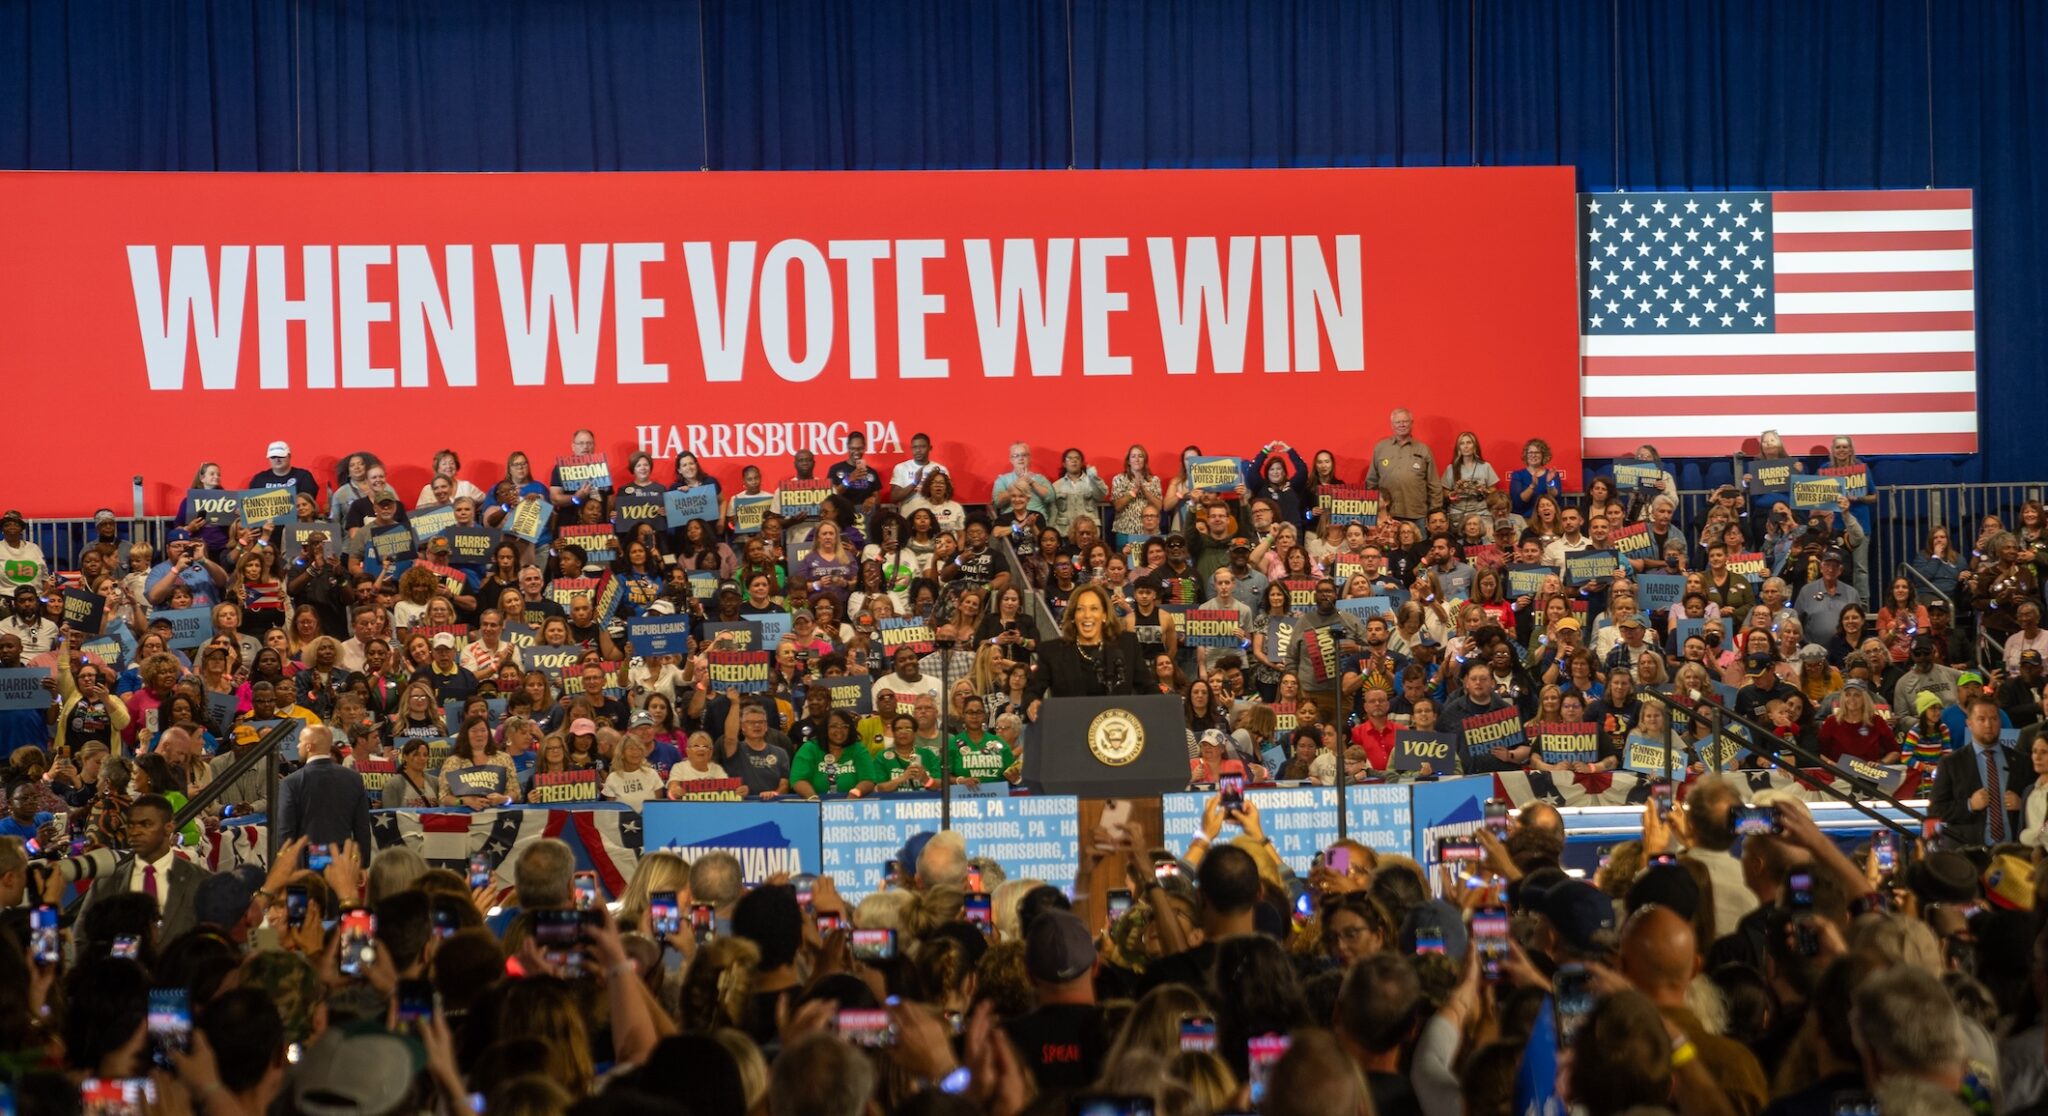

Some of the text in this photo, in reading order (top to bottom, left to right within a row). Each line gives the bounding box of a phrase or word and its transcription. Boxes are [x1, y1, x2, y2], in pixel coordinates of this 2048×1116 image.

[127, 235, 1365, 390] WHEN WE VOTE WE WIN
[865, 421, 904, 455] PA
[559, 463, 608, 480] FREEDOM
[1194, 474, 1236, 484] VOTES EARLY
[1758, 466, 1790, 480] HARRIS
[1763, 478, 1786, 487] WALZ
[674, 495, 708, 510] HARRIS
[1797, 492, 1817, 502] VOTES
[194, 497, 237, 513] vote
[246, 504, 291, 519] VOTES EARLY
[622, 503, 659, 519] vote
[681, 506, 704, 517] WALZ
[1332, 499, 1378, 515] FREEDOM
[739, 515, 759, 524] VOTES
[454, 535, 490, 549] HARRIS
[459, 547, 484, 556] WALZ
[1646, 584, 1680, 595] HARRIS
[1651, 595, 1675, 603] WALZ
[171, 616, 200, 631] ARRIS
[631, 622, 686, 636] REPUBLICANS
[1186, 620, 1239, 636] FREEDOM
[882, 626, 935, 645] FREEDOM
[1277, 623, 1293, 657] vote
[1315, 627, 1336, 679] FREEDOM
[533, 654, 578, 668] vote
[710, 663, 768, 682] FREEDOM
[5, 691, 32, 700] WALZ
[831, 685, 862, 700] ARRIS
[1464, 717, 1521, 746] FREEDOM
[1403, 741, 1448, 758] vote
[1541, 734, 1597, 752] FREEDOM
[962, 754, 1003, 769] HARRIS
[1632, 753, 1656, 766] VOTES
[970, 768, 998, 778] WALZ
[1849, 760, 1888, 778] HARRIS
[459, 771, 500, 785] HARRIS
[469, 781, 496, 790] WALZ
[536, 782, 596, 803] FREEDOM
[623, 782, 644, 793] USA
[864, 804, 880, 820] PA
[987, 800, 1004, 817] PA
[1363, 809, 1379, 826] PA
[1029, 821, 1046, 837] PA
[1165, 839, 1181, 857] PA
[1284, 833, 1301, 851] PA
[822, 849, 840, 865] PA
[979, 841, 1066, 863] HARRISBURG,
[865, 869, 882, 886] PA
